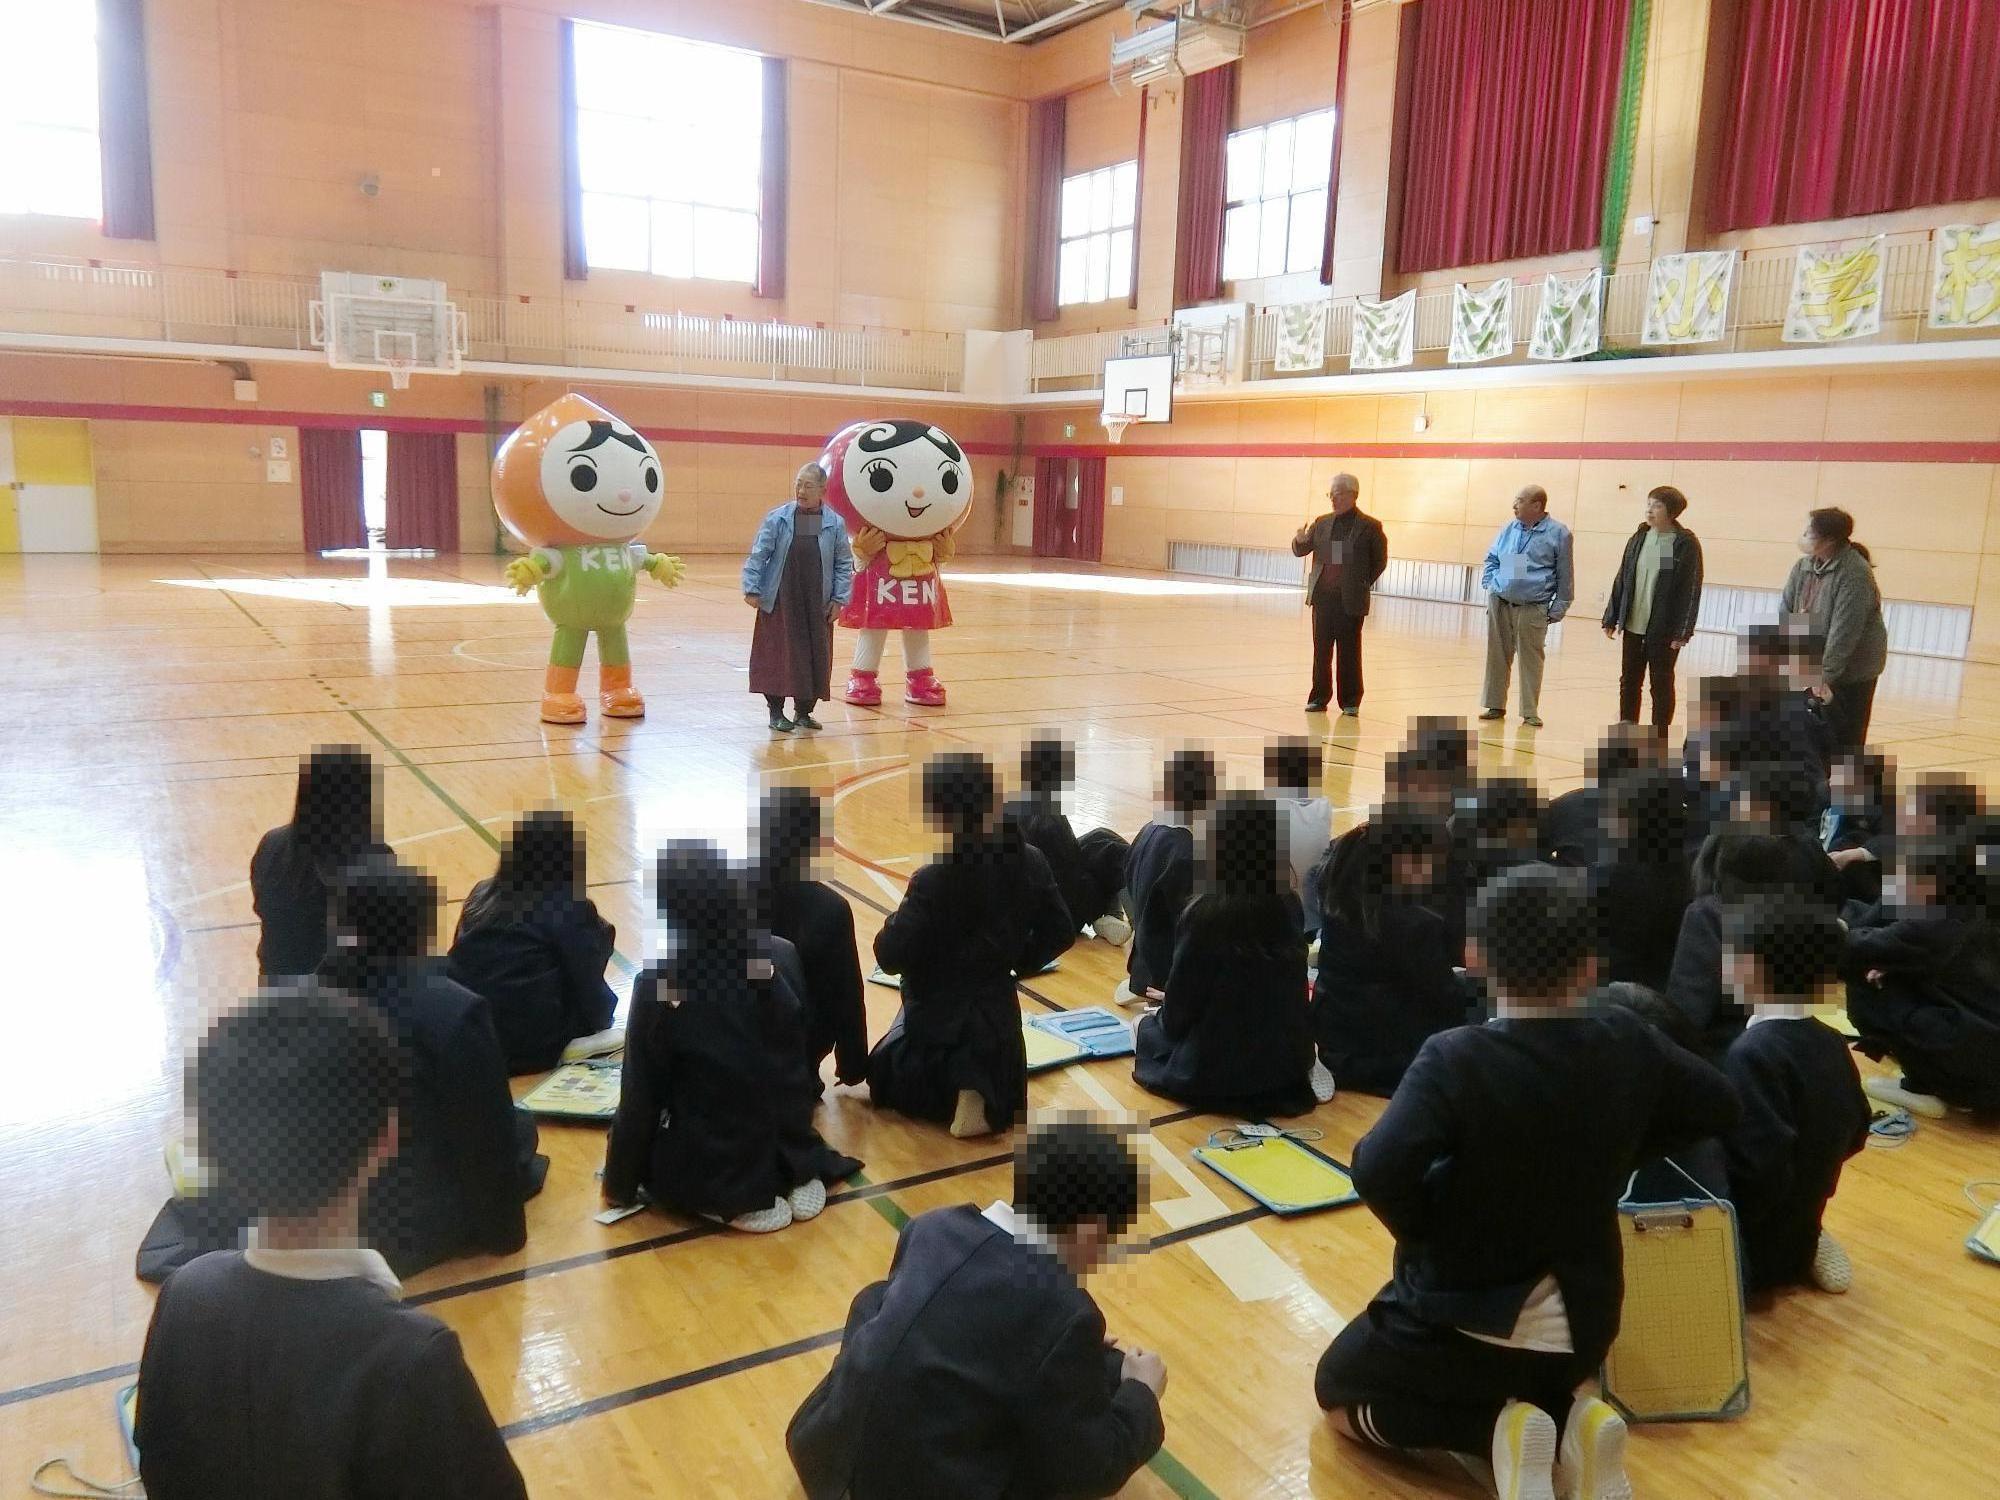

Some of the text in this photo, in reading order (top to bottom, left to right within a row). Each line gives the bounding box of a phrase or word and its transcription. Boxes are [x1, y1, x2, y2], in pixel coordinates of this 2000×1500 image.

[1654, 258, 1723, 337] 小
[1801, 254, 1879, 337] 学
[877, 577, 937, 605] KEN
